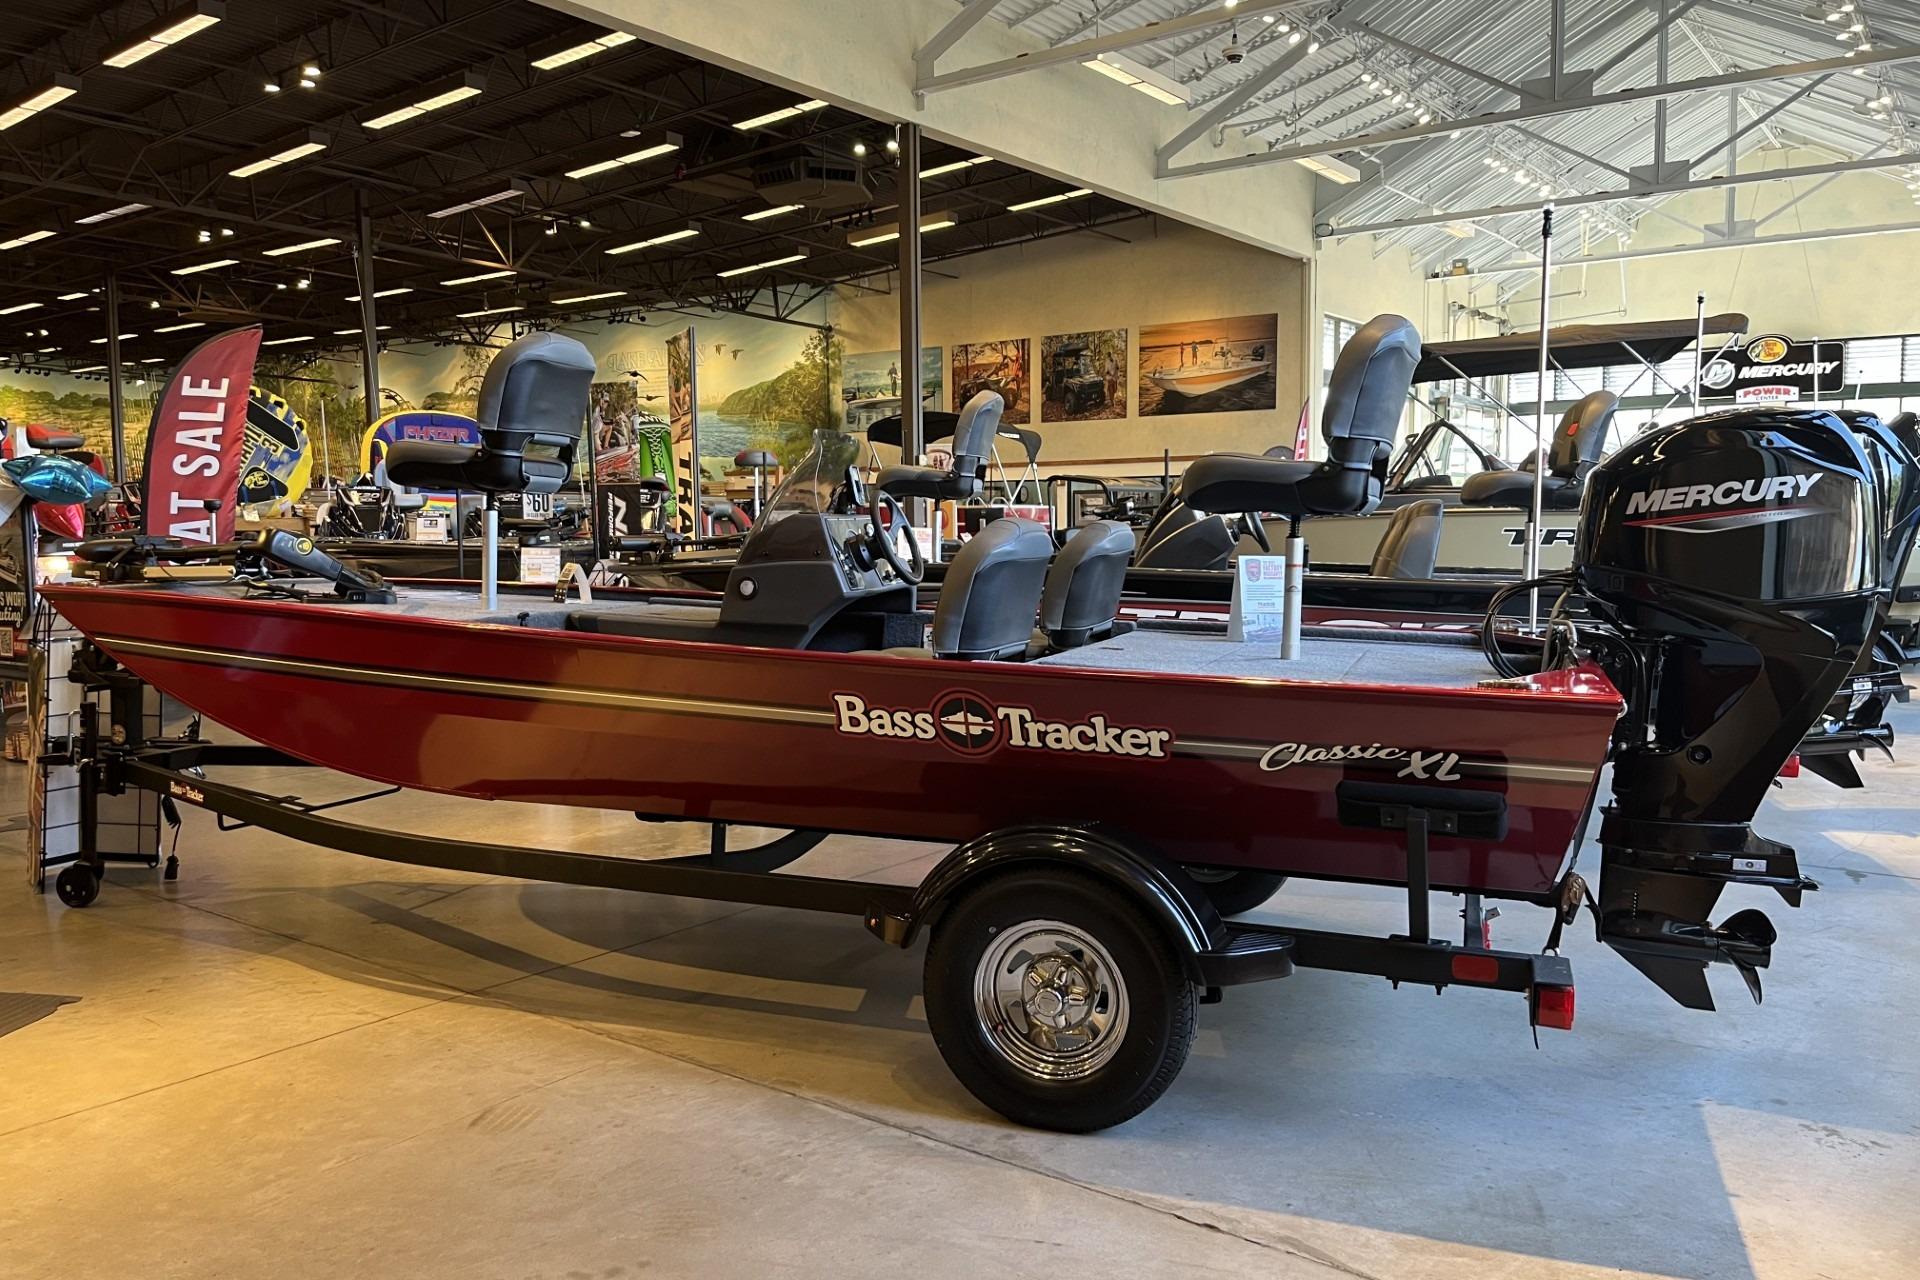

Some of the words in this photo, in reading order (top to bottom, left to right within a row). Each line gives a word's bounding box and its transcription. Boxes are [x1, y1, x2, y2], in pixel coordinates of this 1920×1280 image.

[1738, 361, 1840, 379] MERCURY
[1743, 387, 1791, 399] POWER
[172, 375, 230, 477] SALE
[1625, 473, 1824, 515] MERCURY
[834, 694, 936, 739] Bass
[997, 707, 1169, 757] Tracker
[1259, 742, 1407, 772] Classic
[1397, 751, 1461, 781] XL
